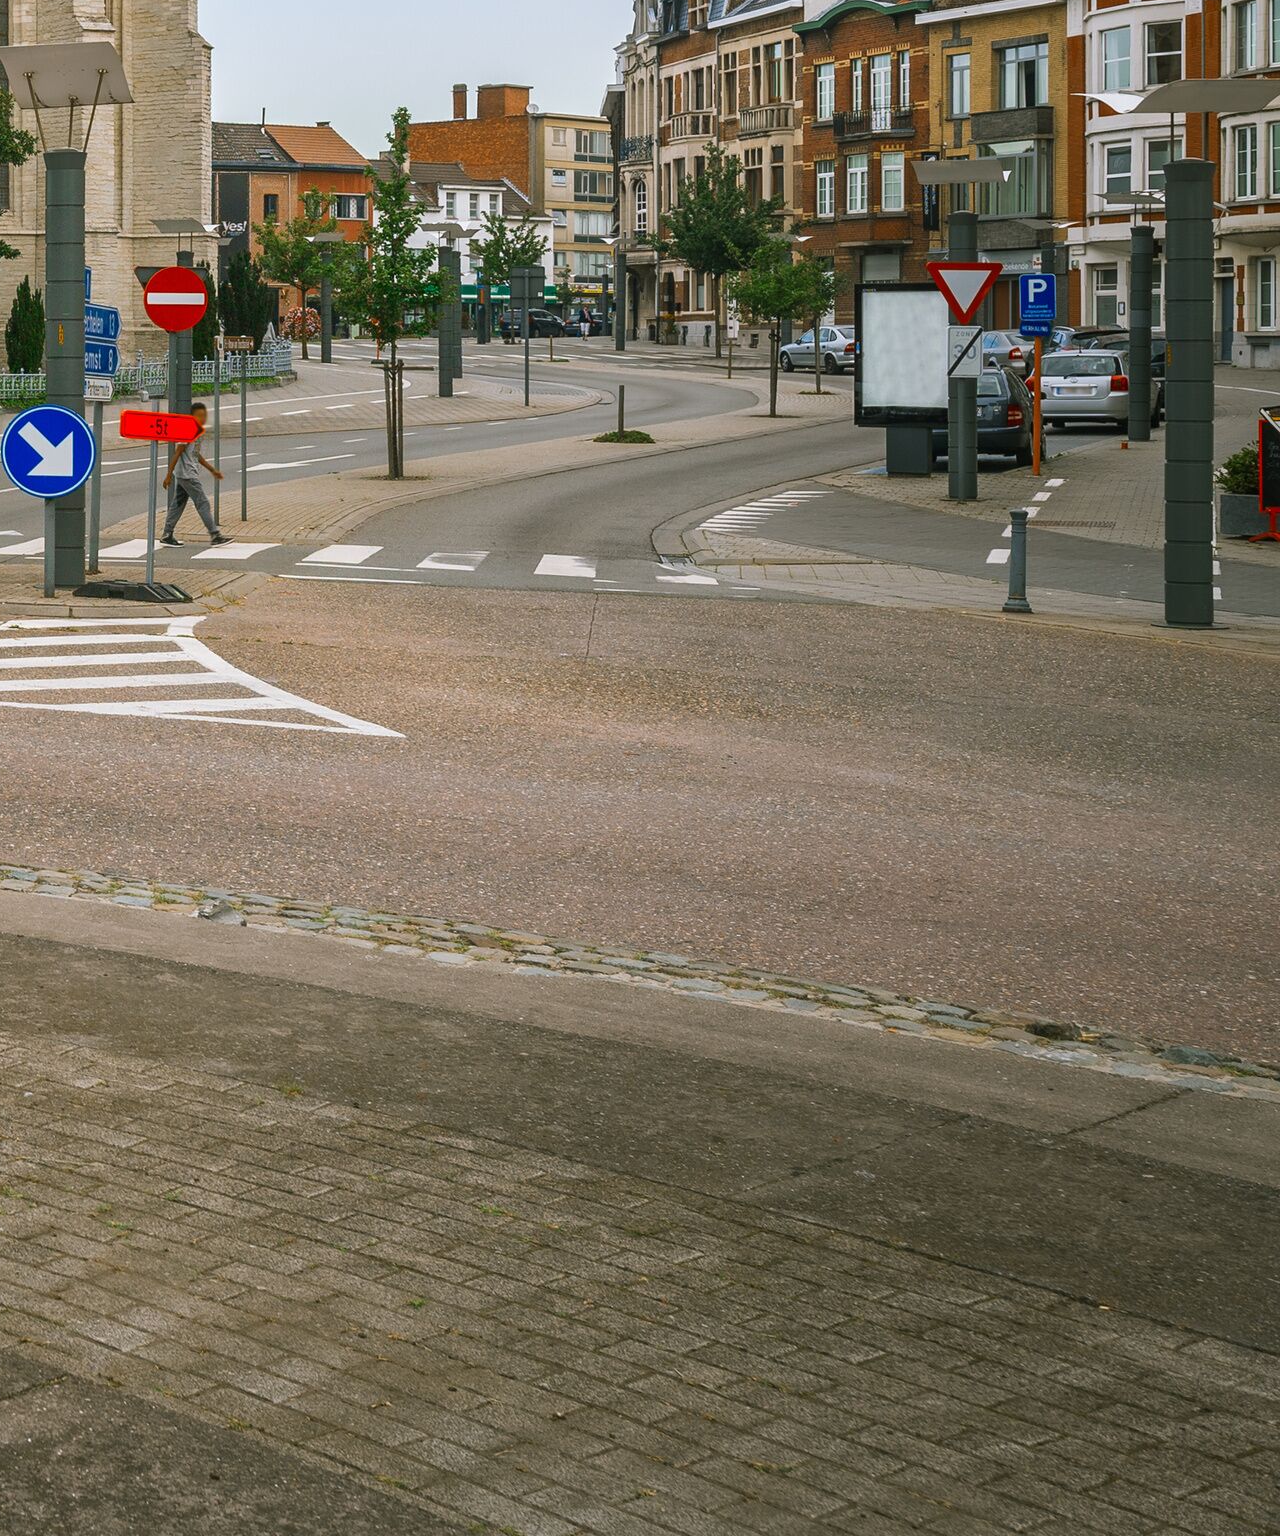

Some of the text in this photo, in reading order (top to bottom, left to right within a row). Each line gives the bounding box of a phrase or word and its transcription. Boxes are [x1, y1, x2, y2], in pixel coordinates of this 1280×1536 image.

[1028, 278, 1048, 303] P
[84, 310, 104, 335] echelen
[84, 349, 113, 371] emst 8
[953, 344, 977, 360] 30
